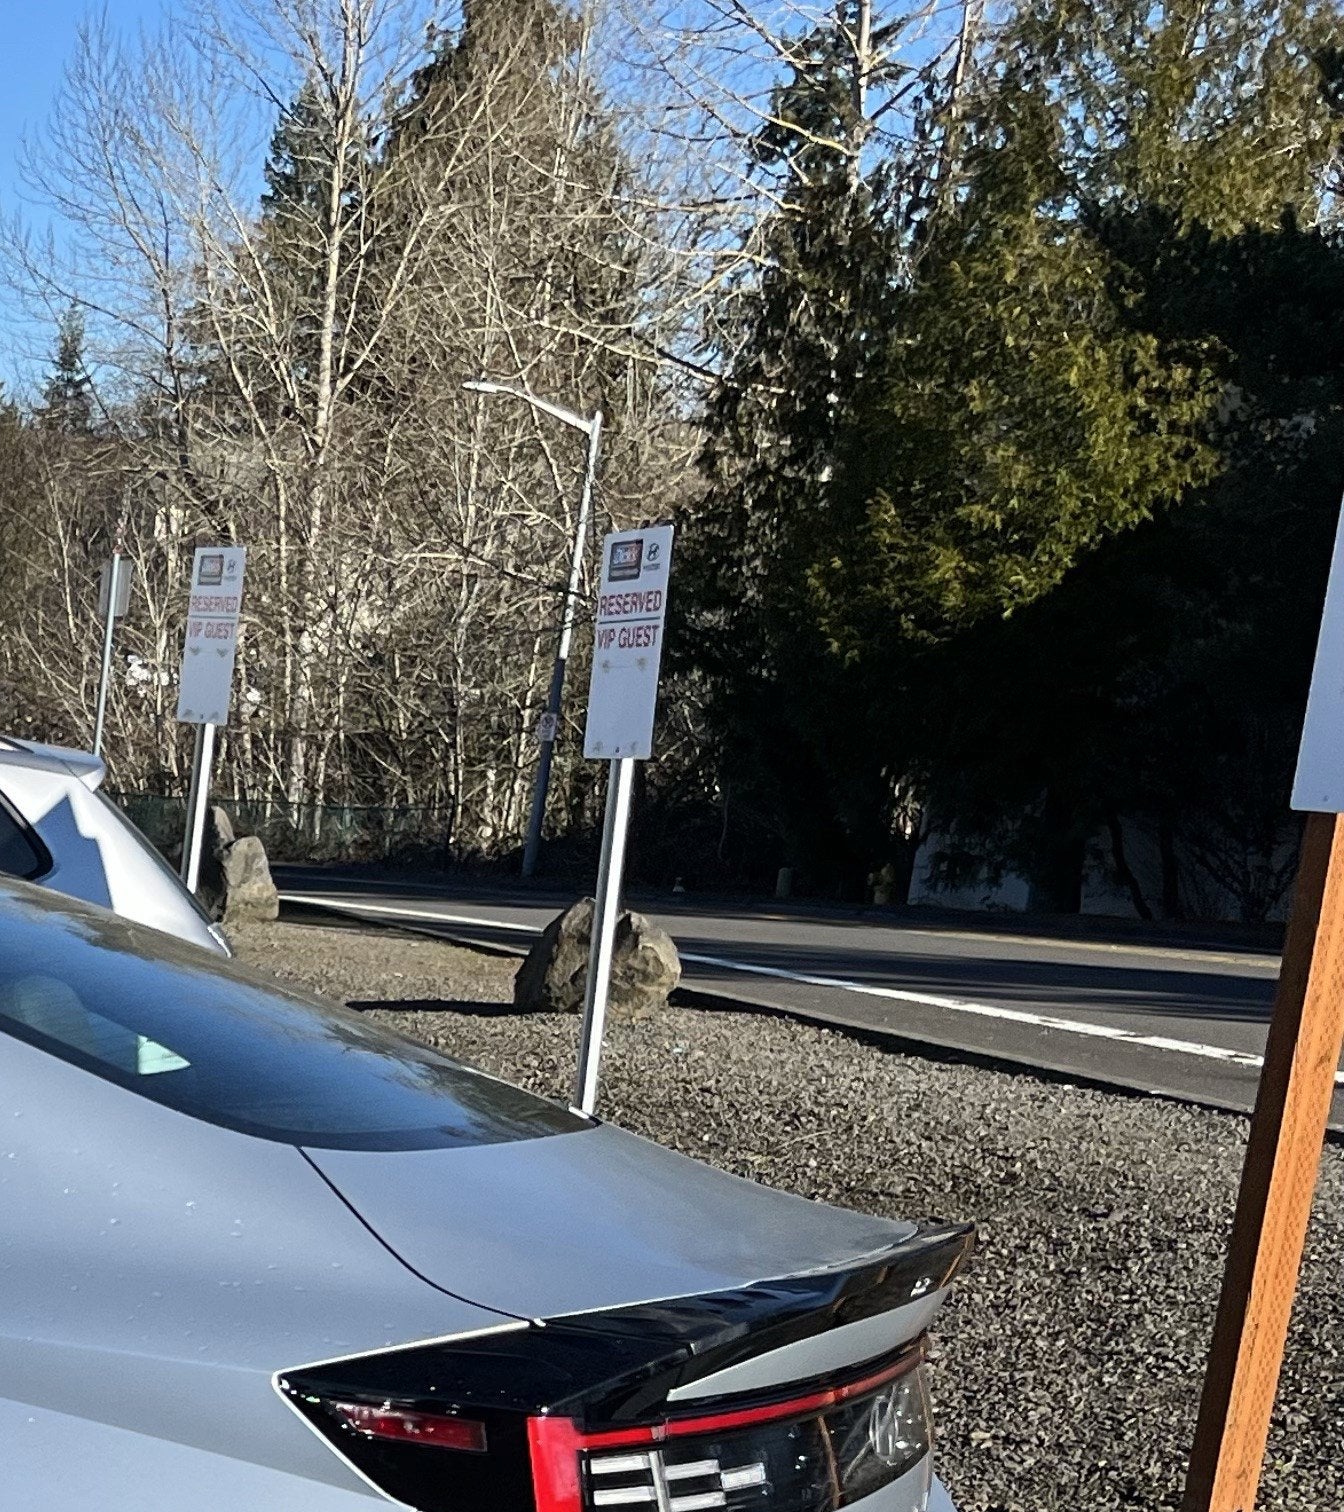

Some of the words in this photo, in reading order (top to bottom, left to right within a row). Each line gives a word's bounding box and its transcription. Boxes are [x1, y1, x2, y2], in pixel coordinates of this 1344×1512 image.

[599, 590, 662, 616] RESERVED
[597, 627, 616, 650] VIP
[618, 624, 660, 649] GUEST
